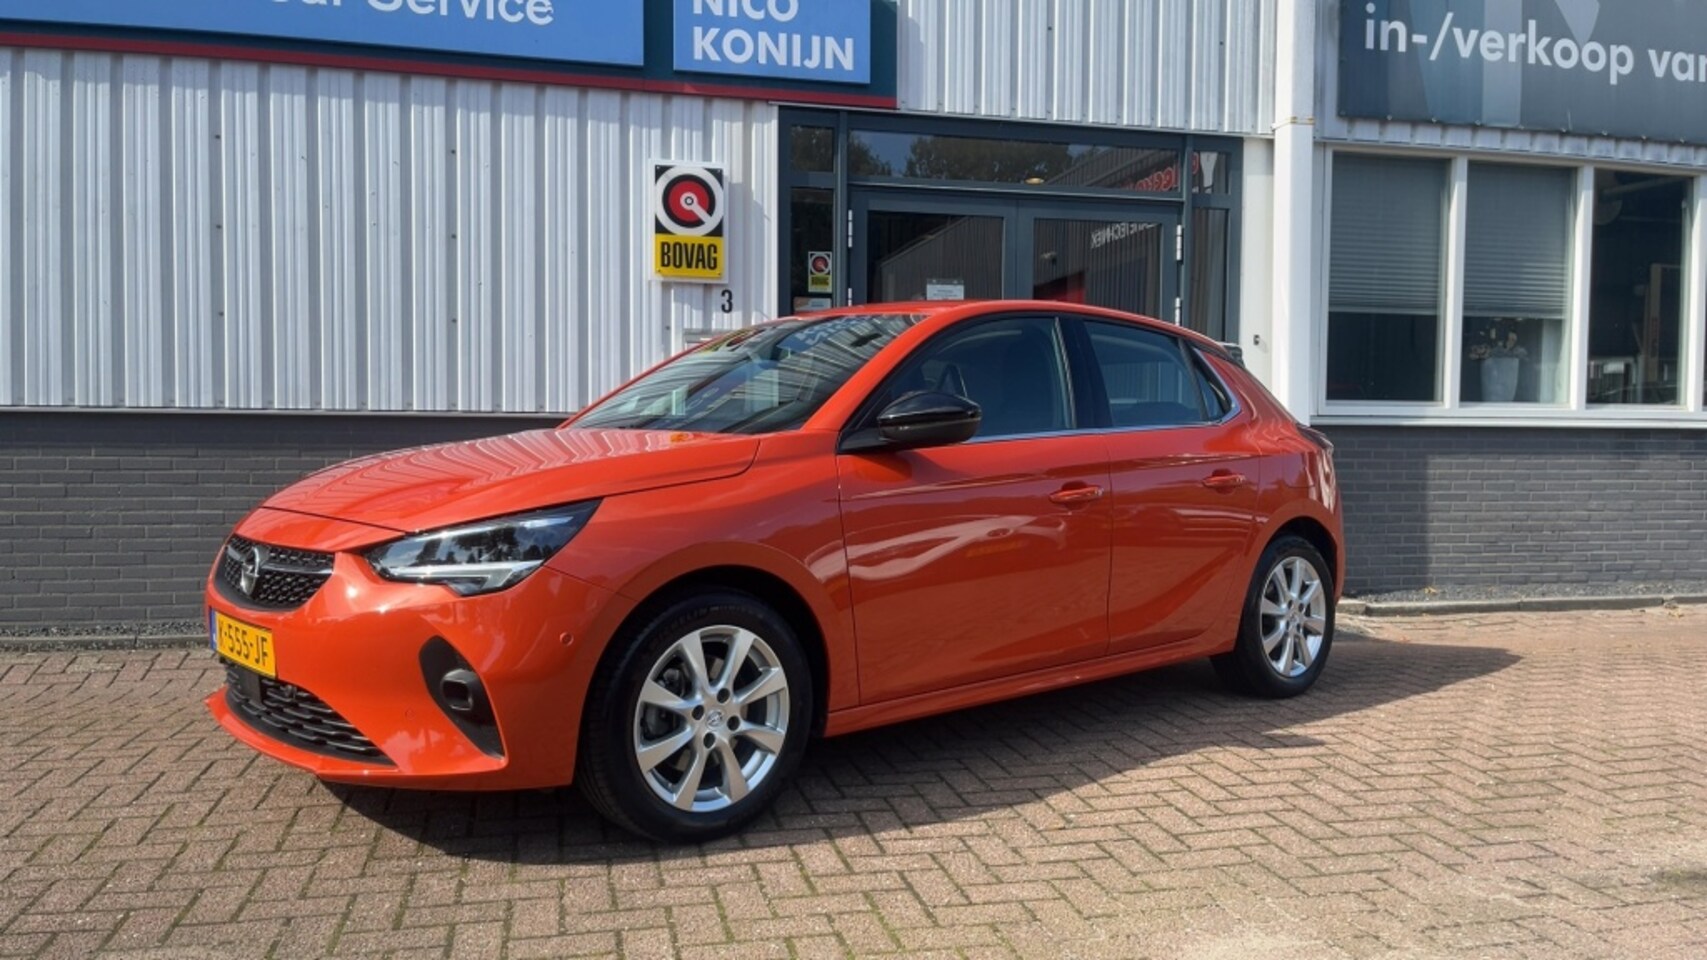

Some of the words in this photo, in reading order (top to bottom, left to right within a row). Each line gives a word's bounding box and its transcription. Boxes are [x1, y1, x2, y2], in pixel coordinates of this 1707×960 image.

[692, 26, 854, 71] KONIJN
[1364, 2, 1634, 85] in-/verkoop
[660, 241, 718, 270] BOVAG
[721, 289, 733, 313] 3
